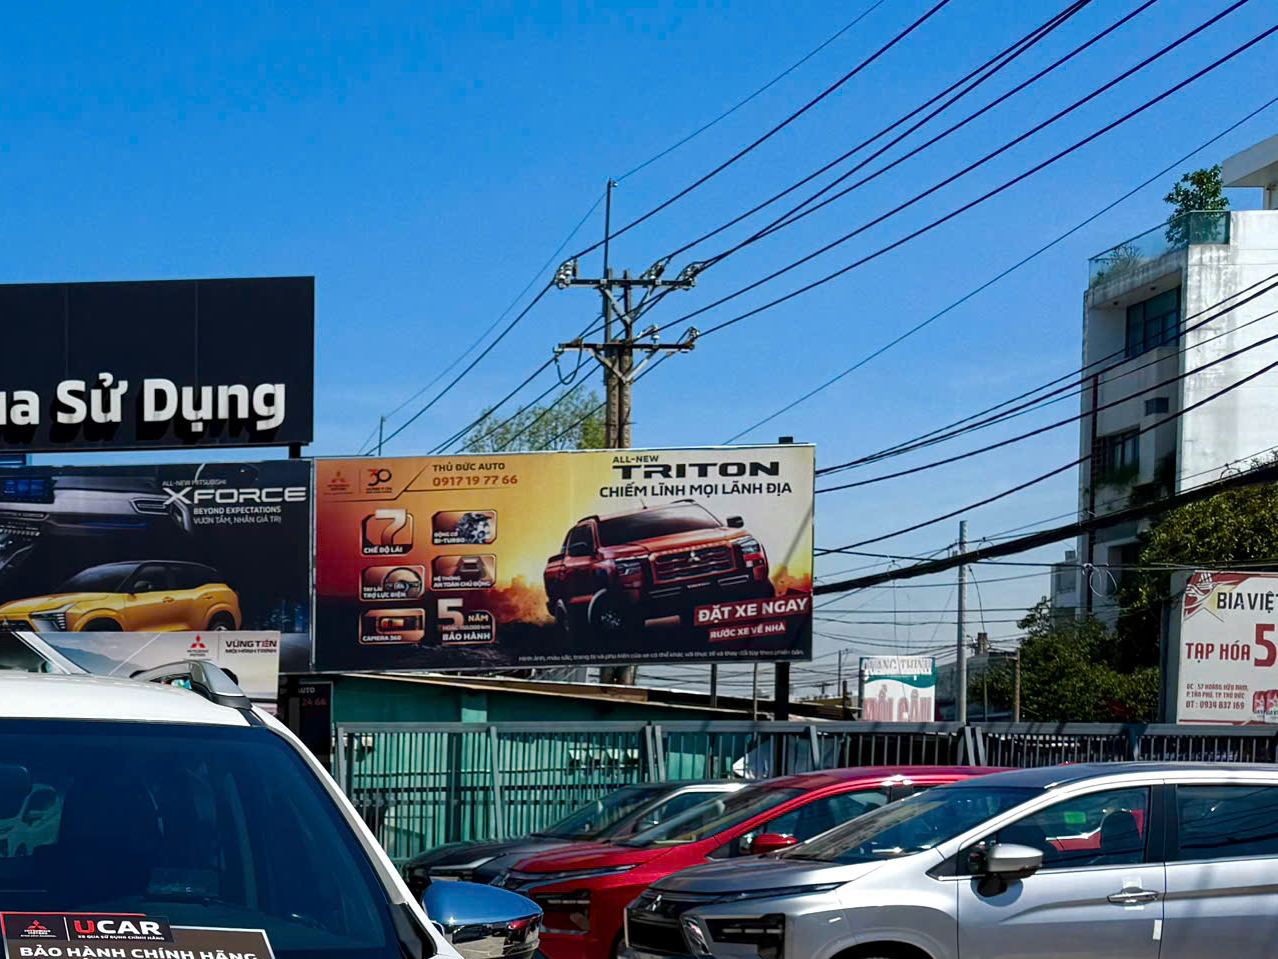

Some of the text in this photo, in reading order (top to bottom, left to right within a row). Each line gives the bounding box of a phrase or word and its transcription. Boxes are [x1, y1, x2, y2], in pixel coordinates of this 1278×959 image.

[56, 372, 129, 425] Sử
[143, 378, 286, 432] Dụng
[612, 455, 659, 463] ALL-NEW
[432, 462, 506, 472] THỦ ĐỨC AUTO
[612, 461, 780, 480] TRITON
[432, 475, 518, 487] 0917 19 77 66
[162, 486, 307, 505] XFORCE
[599, 480, 792, 498] CHIẾM LĨNH MỌI LÃNH ĐỊA
[193, 505, 282, 515] BEYOND EXPECTATIONS
[1216, 591, 1278, 613] BIA VIỆ
[467, 614, 489, 622] NĂM
[698, 597, 809, 624] ĐẶT XE NGAY
[442, 631, 491, 641] BẢO HÀNH
[737, 627, 750, 636] XE
[751, 624, 764, 634] VỀ
[765, 622, 786, 633] NHÀ
[1185, 623, 1277, 667] TẠP HÓA 5
[1199, 701, 1217, 709] 0934
[1218, 701, 1231, 709] 837
[1233, 701, 1245, 709] 169
[73, 919, 162, 936] UCAR
[19, 944, 62, 957] BẢO
[67, 945, 125, 958] HÀNH
[131, 947, 195, 959] CHÍNH
